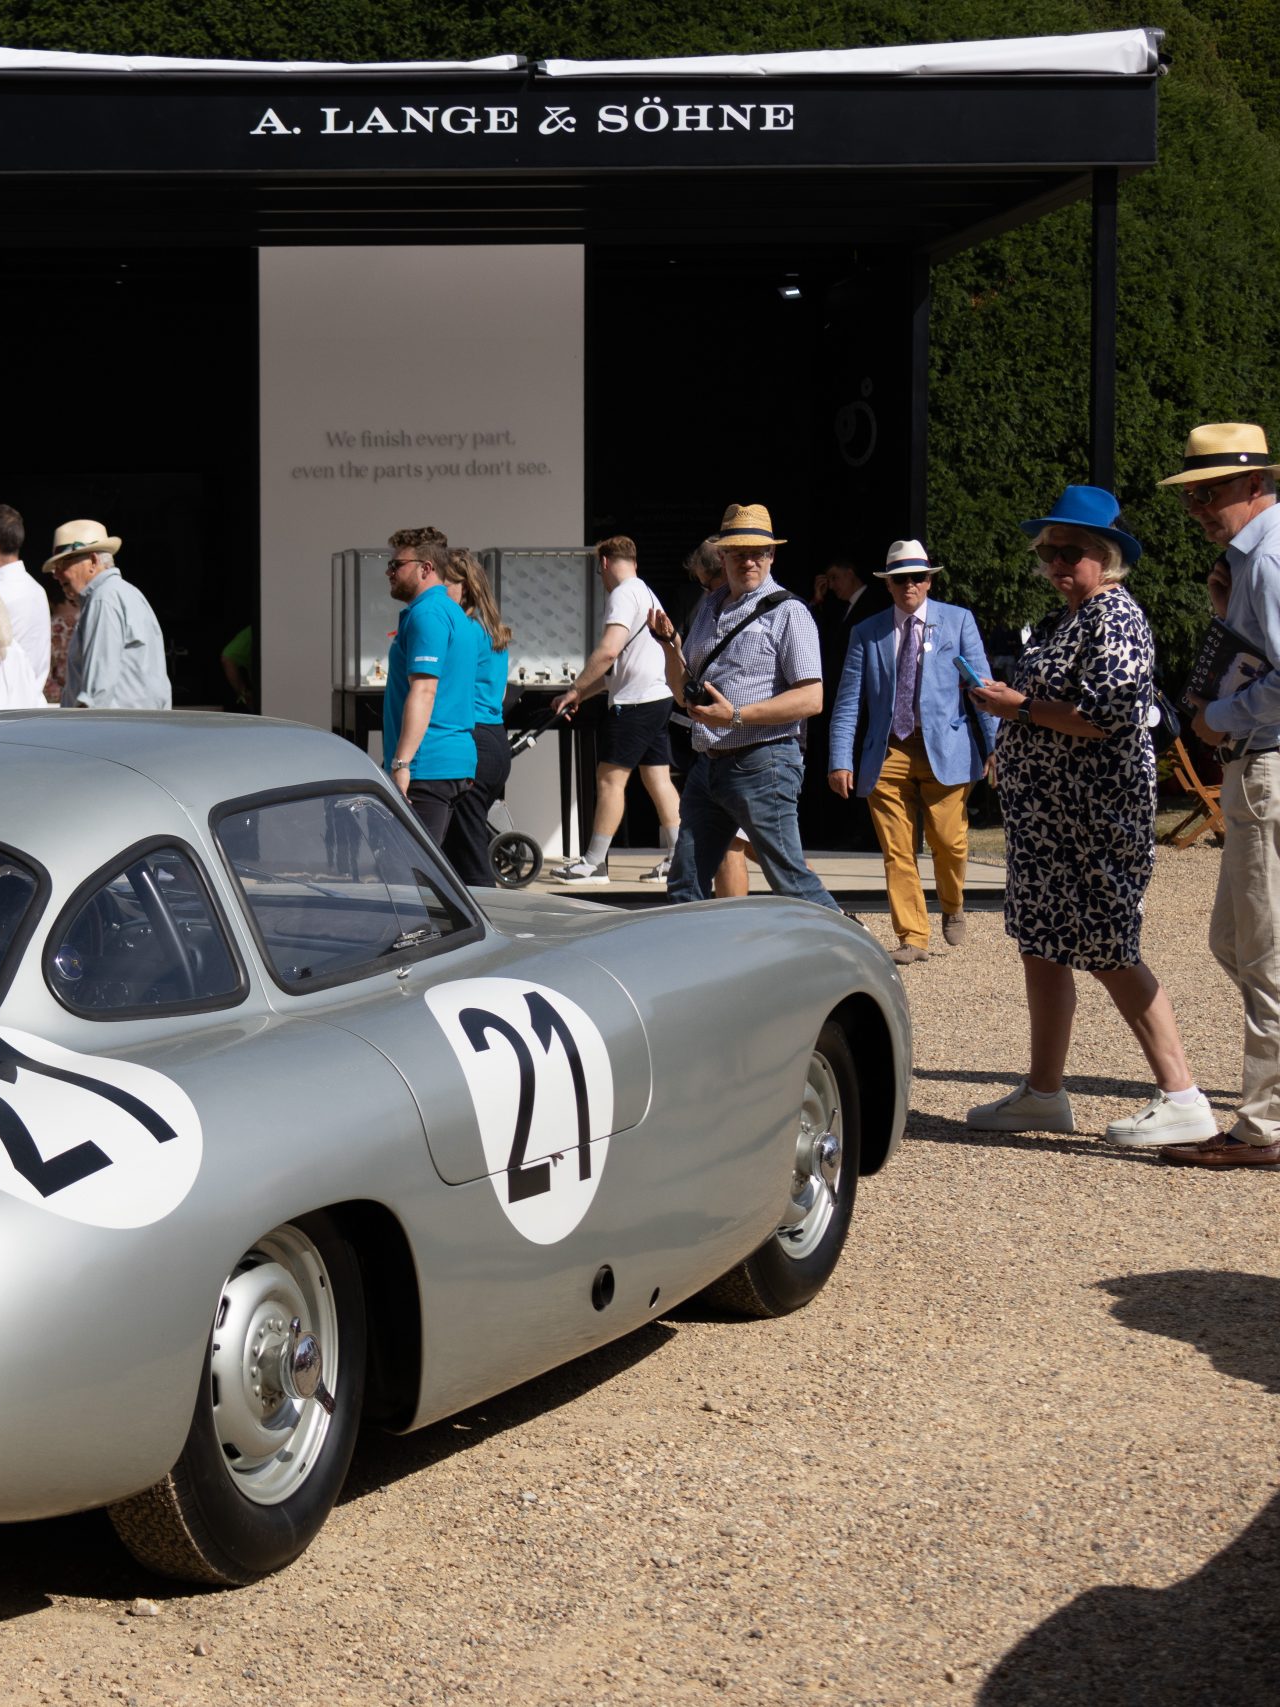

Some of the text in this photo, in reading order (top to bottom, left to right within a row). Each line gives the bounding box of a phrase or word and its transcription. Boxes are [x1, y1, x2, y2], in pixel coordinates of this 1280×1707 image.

[249, 96, 794, 135] A. LANGE & SÖHNE
[326, 431, 356, 448] We
[361, 430, 413, 448] finish
[416, 434, 467, 450] every
[291, 459, 552, 483] even the parts you don't see.
[458, 991, 592, 1204] 21
